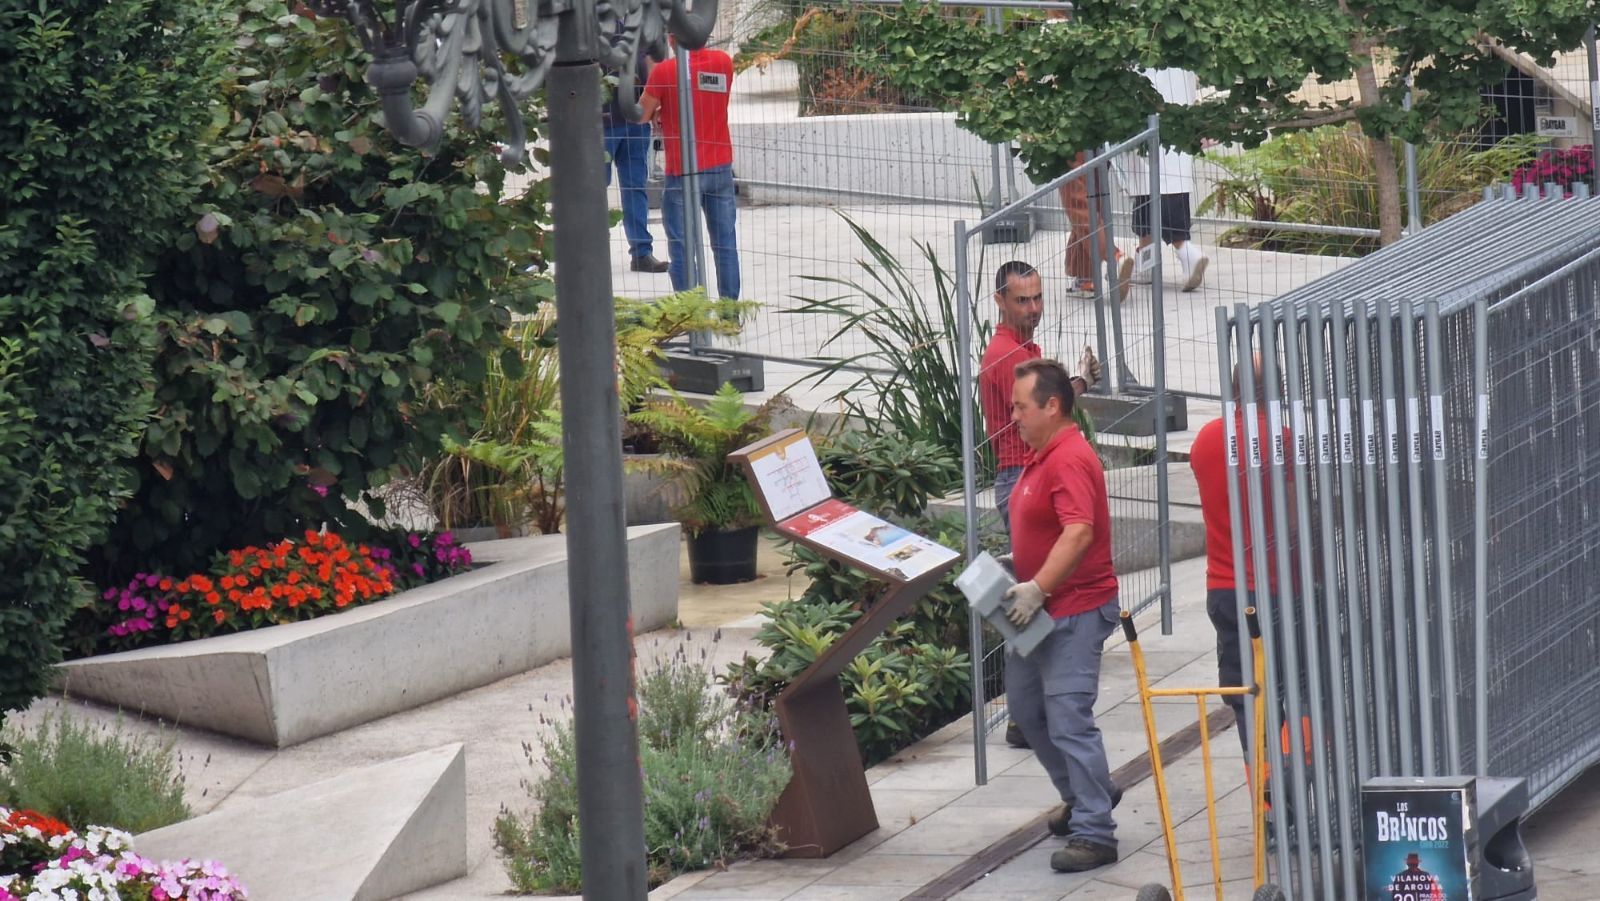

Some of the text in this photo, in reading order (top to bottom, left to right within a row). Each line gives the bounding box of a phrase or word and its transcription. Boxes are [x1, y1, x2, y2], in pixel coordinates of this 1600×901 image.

[1397, 802, 1408, 812] LOS
[1377, 811, 1448, 841] BRINCOS
[1390, 874, 1440, 882] VILANOVA
[1404, 883, 1443, 891] AROUSA
